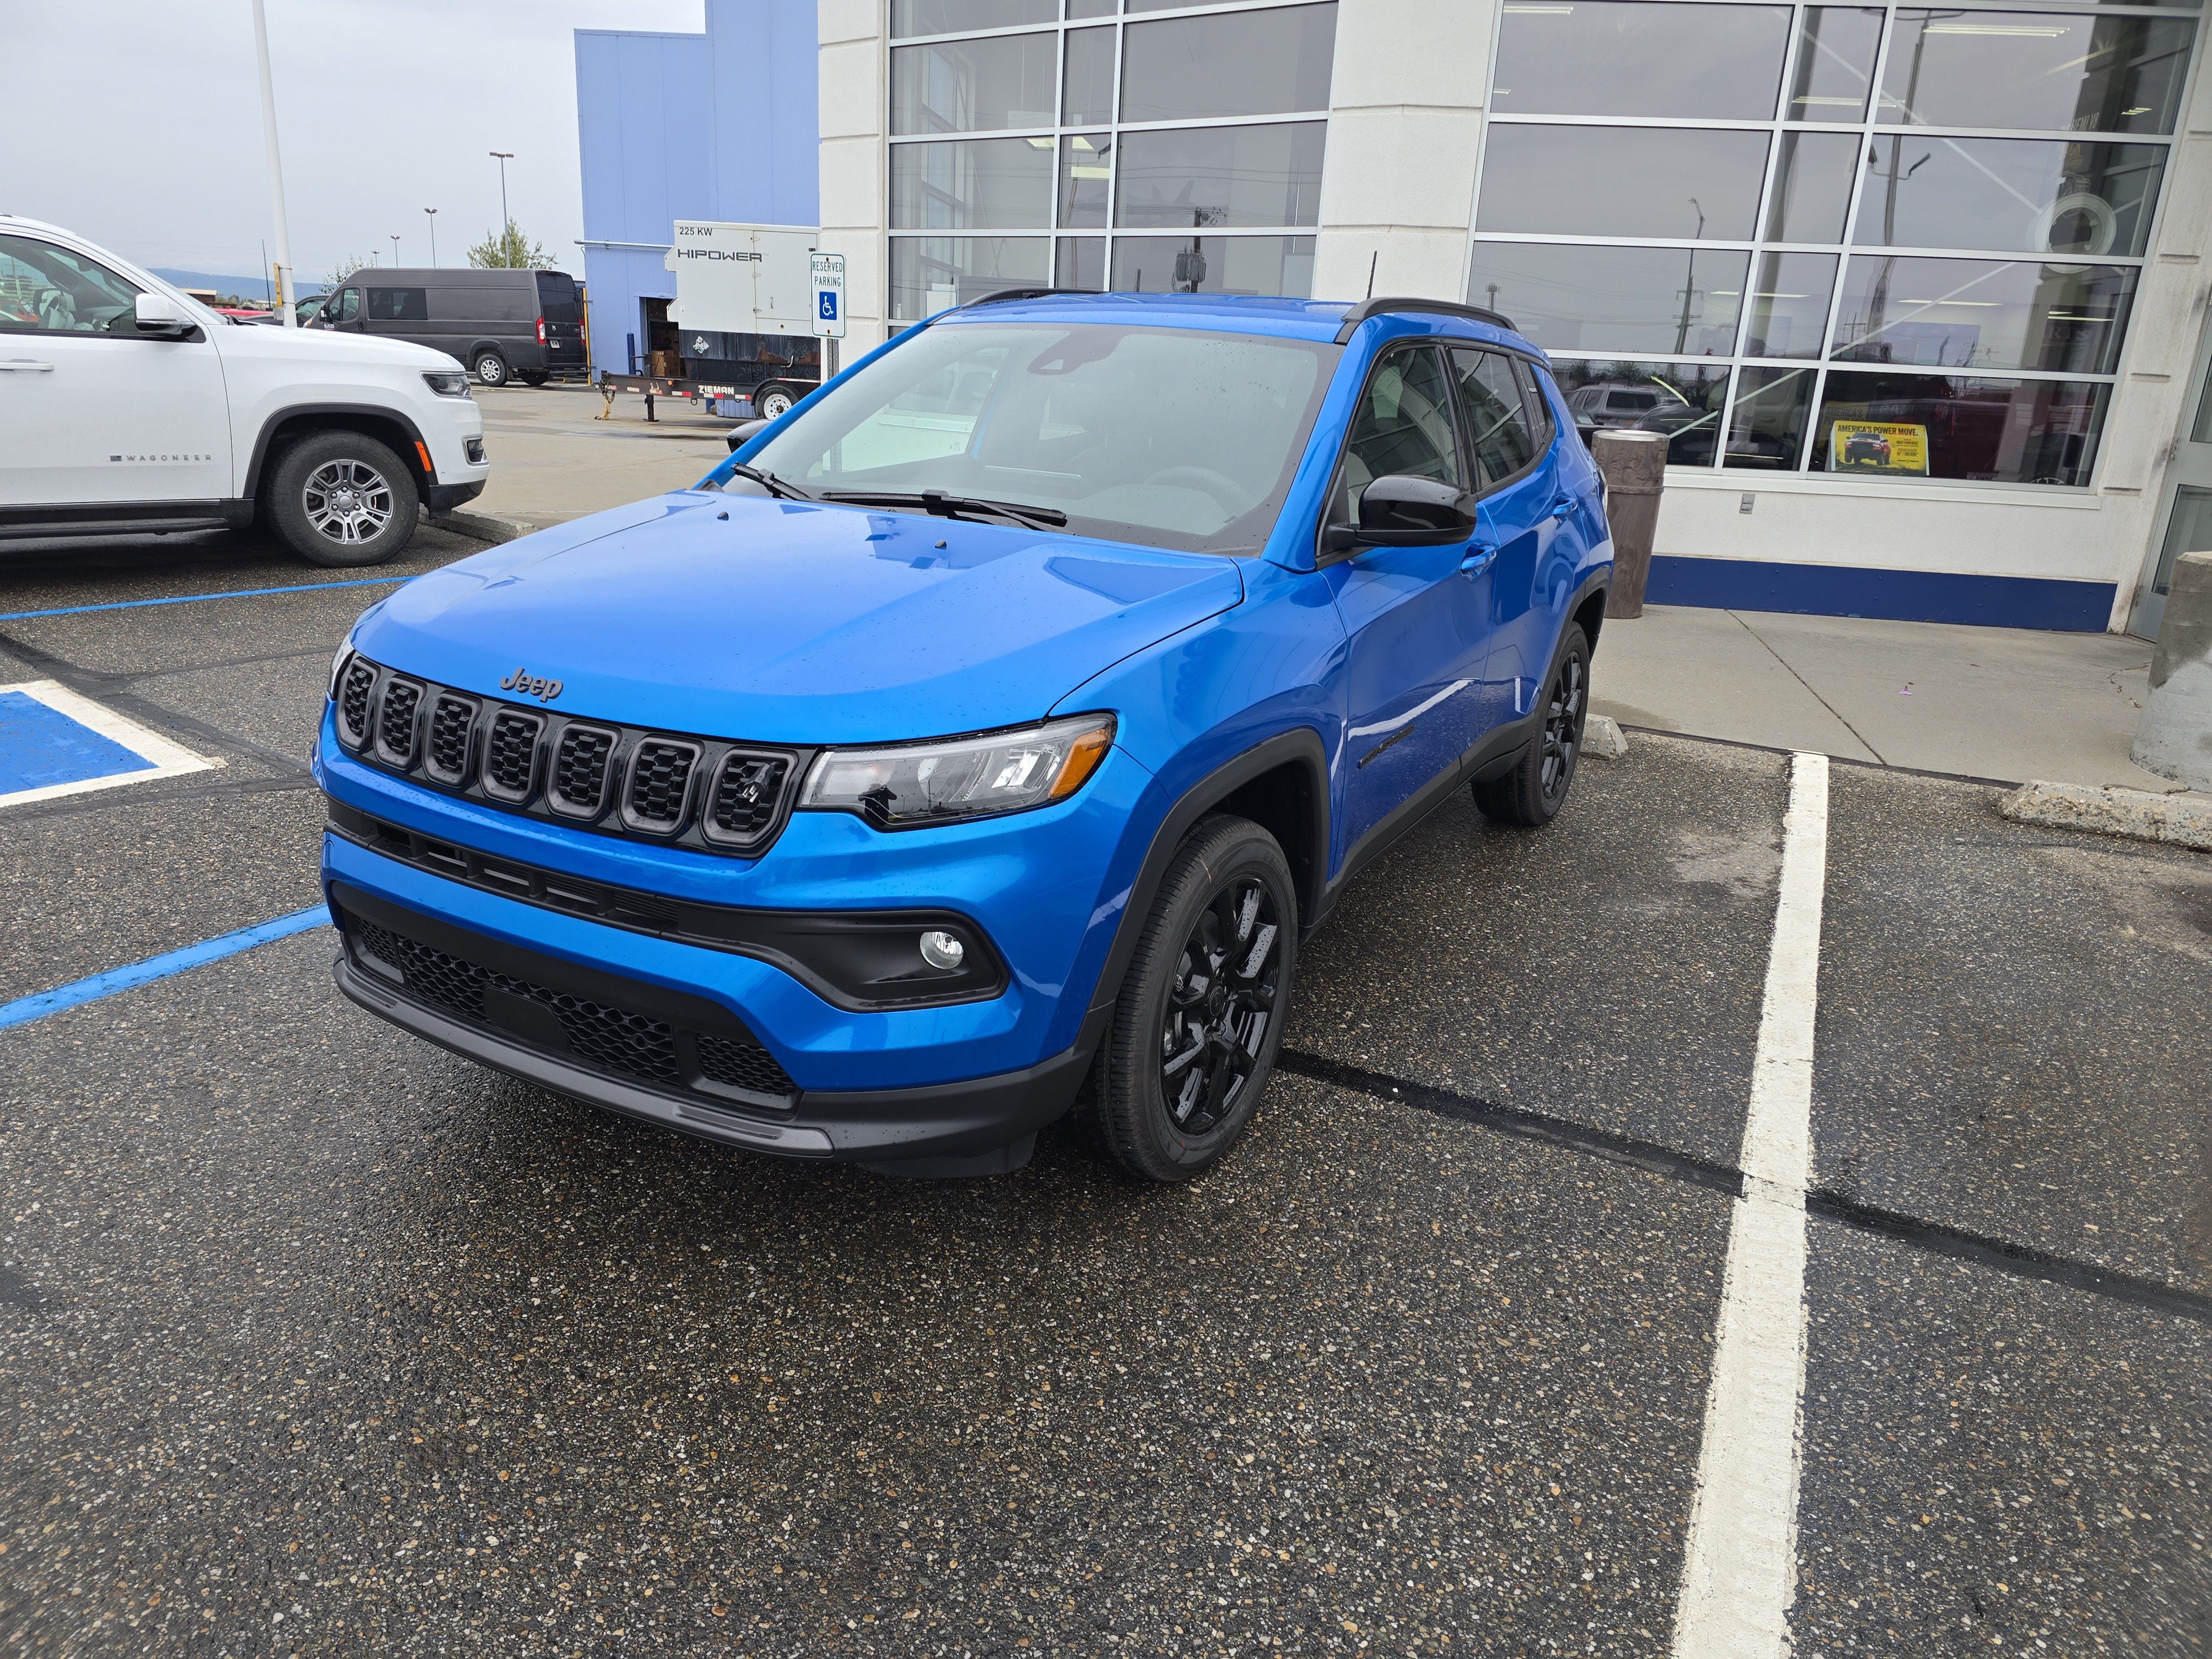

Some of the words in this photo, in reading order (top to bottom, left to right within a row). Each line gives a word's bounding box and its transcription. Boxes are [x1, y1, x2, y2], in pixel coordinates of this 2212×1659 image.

[679, 227, 695, 235] 225
[697, 227, 712, 236] KW
[677, 248, 762, 262] HIPOWER
[812, 261, 843, 272] RESERVED
[814, 275, 841, 287] PARKING
[698, 385, 735, 395] ZIEMAN
[1837, 425, 1872, 433] AMERICA'S
[1873, 426, 1896, 435] POWER
[1898, 427, 1918, 436] MOVE.
[499, 666, 563, 703] Jeep
